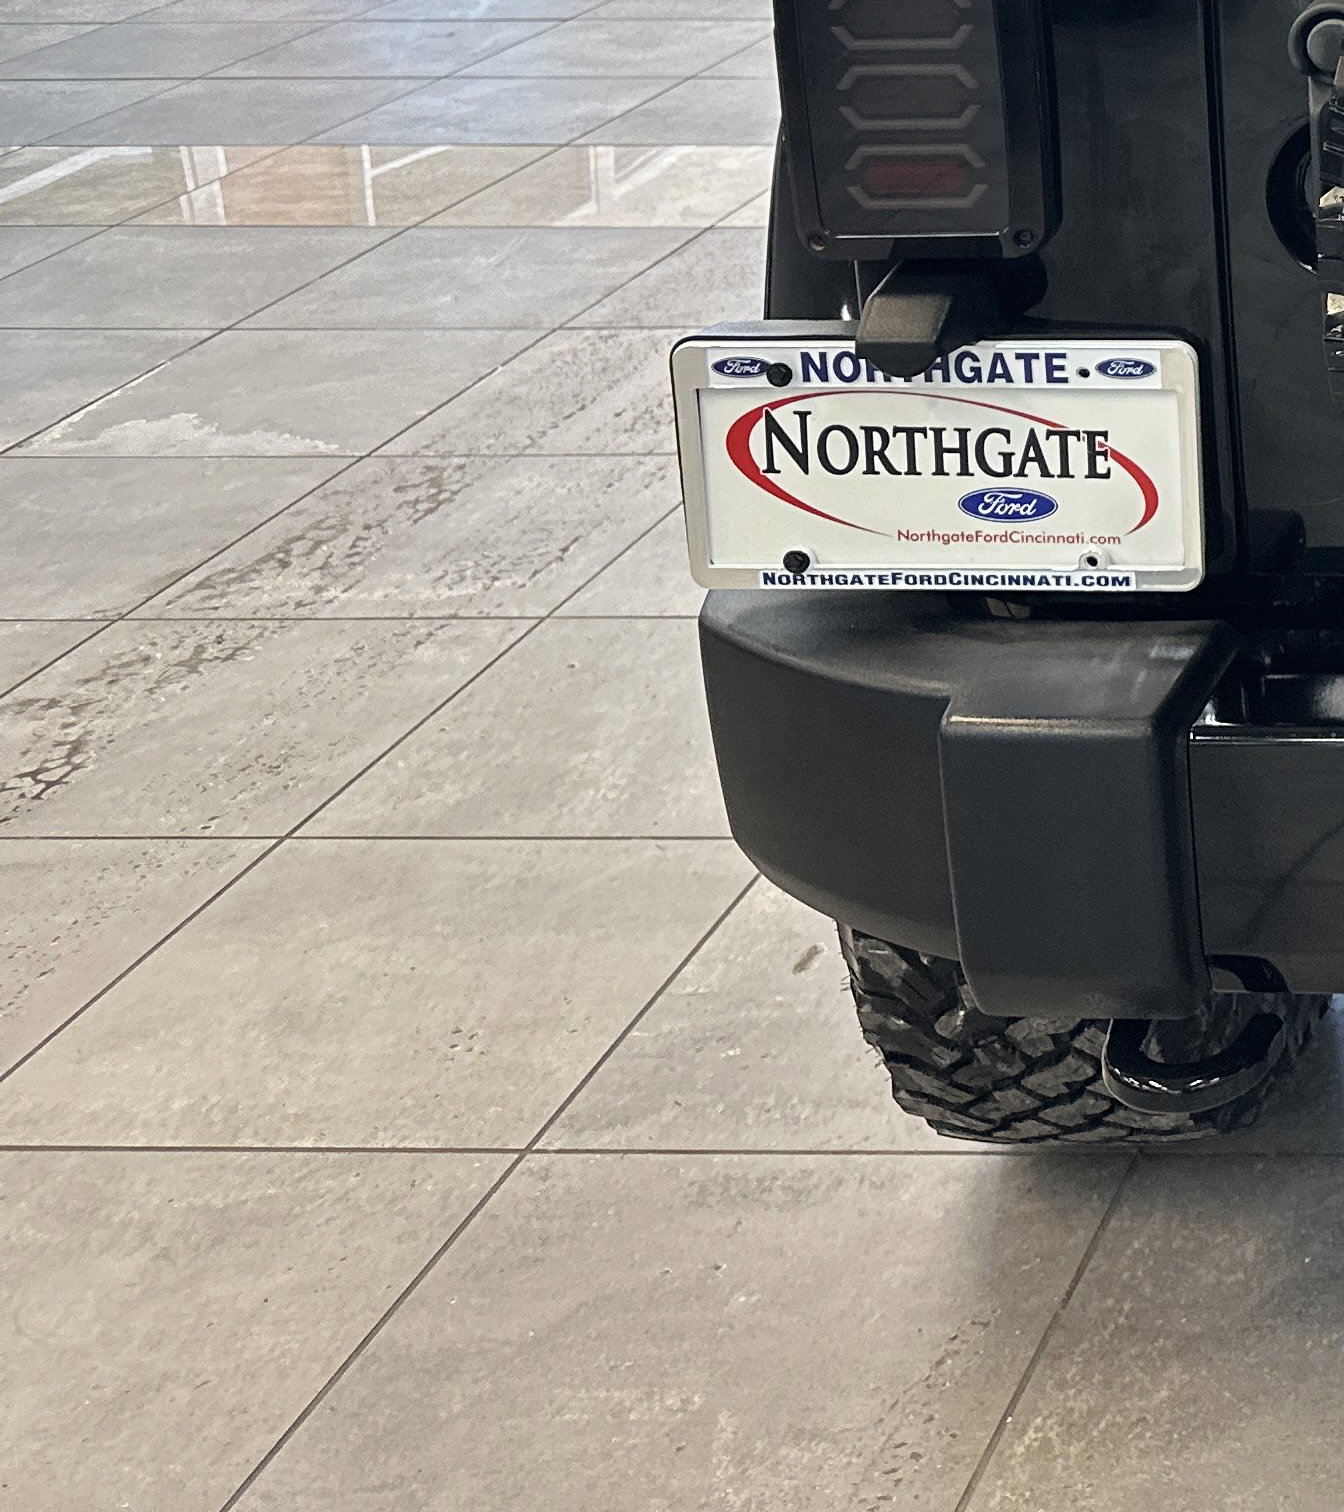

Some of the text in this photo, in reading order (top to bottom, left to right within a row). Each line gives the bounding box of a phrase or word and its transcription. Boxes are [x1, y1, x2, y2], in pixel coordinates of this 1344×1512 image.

[800, 350, 1069, 384] NOHGATE
[762, 409, 1111, 479] NORTHGATE
[978, 492, 1037, 516] Ford
[897, 529, 1121, 545] NorthgateFordCincinnati.com
